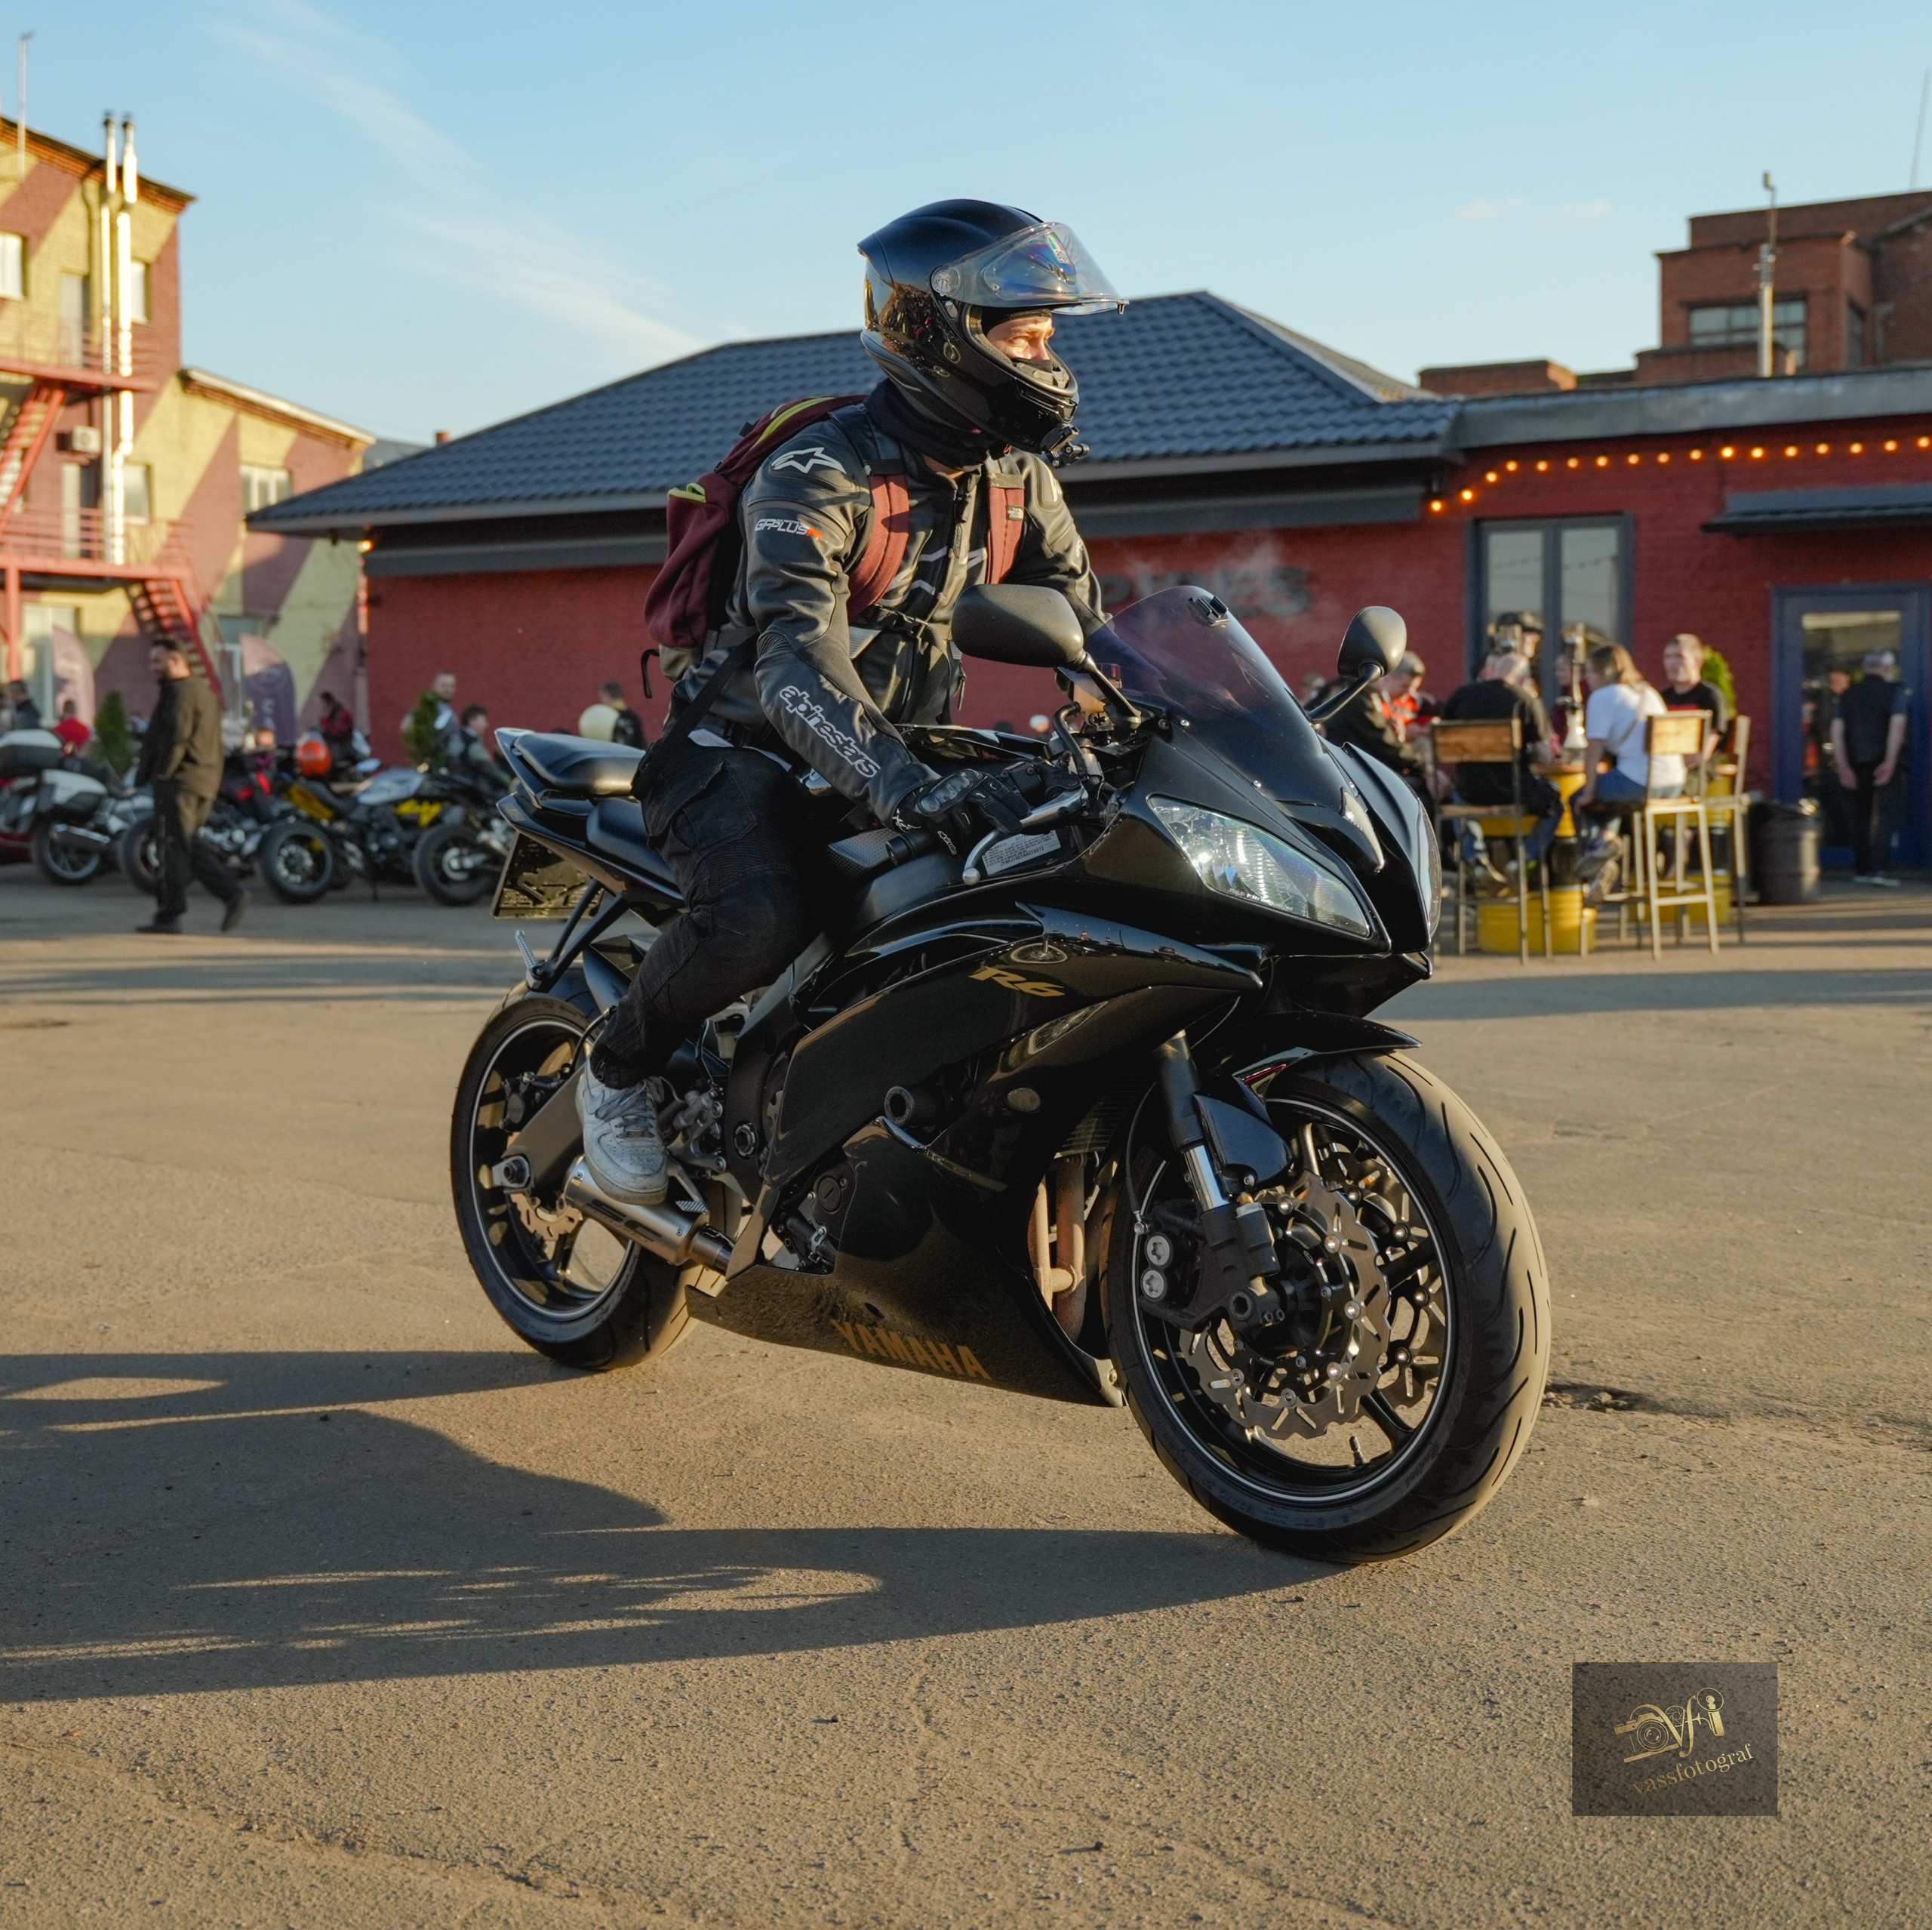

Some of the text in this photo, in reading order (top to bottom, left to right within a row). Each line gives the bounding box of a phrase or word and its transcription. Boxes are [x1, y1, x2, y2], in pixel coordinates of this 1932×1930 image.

[780, 685, 881, 778] alpinestars
[968, 966, 1065, 997] R6
[831, 1319, 991, 1380] YAMAHA
